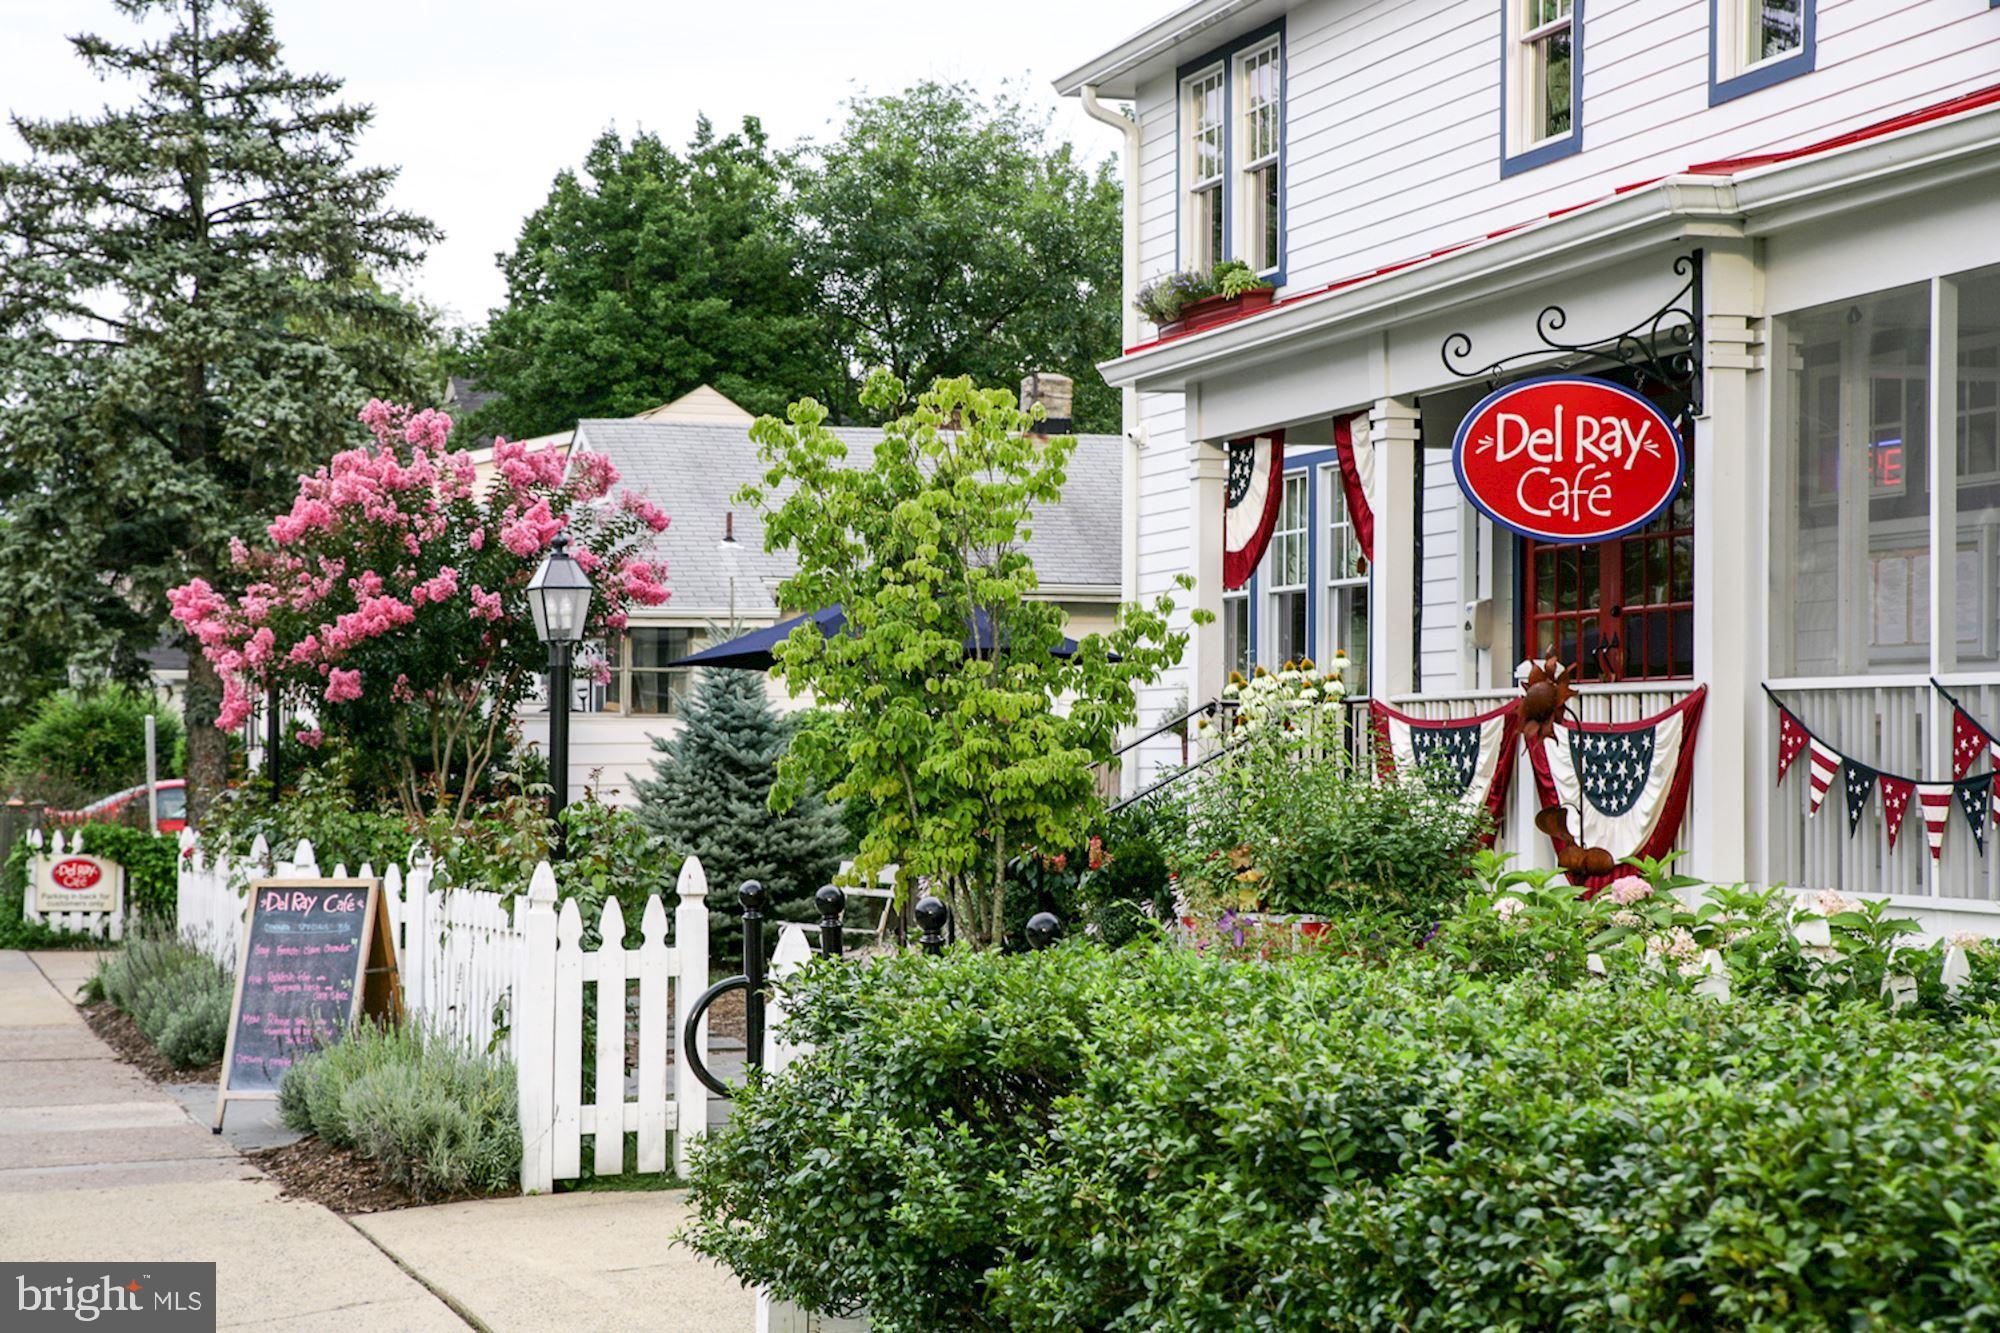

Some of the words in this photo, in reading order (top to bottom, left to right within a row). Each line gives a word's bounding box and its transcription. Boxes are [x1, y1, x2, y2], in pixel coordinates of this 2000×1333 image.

[1495, 404, 1564, 463] Del
[1575, 415, 1651, 470] Ray
[1516, 463, 1612, 522] Café
[41, 893, 69, 901] Parking
[265, 891, 289, 912] Del
[291, 891, 318, 917] Ray
[323, 893, 355, 913] Café
